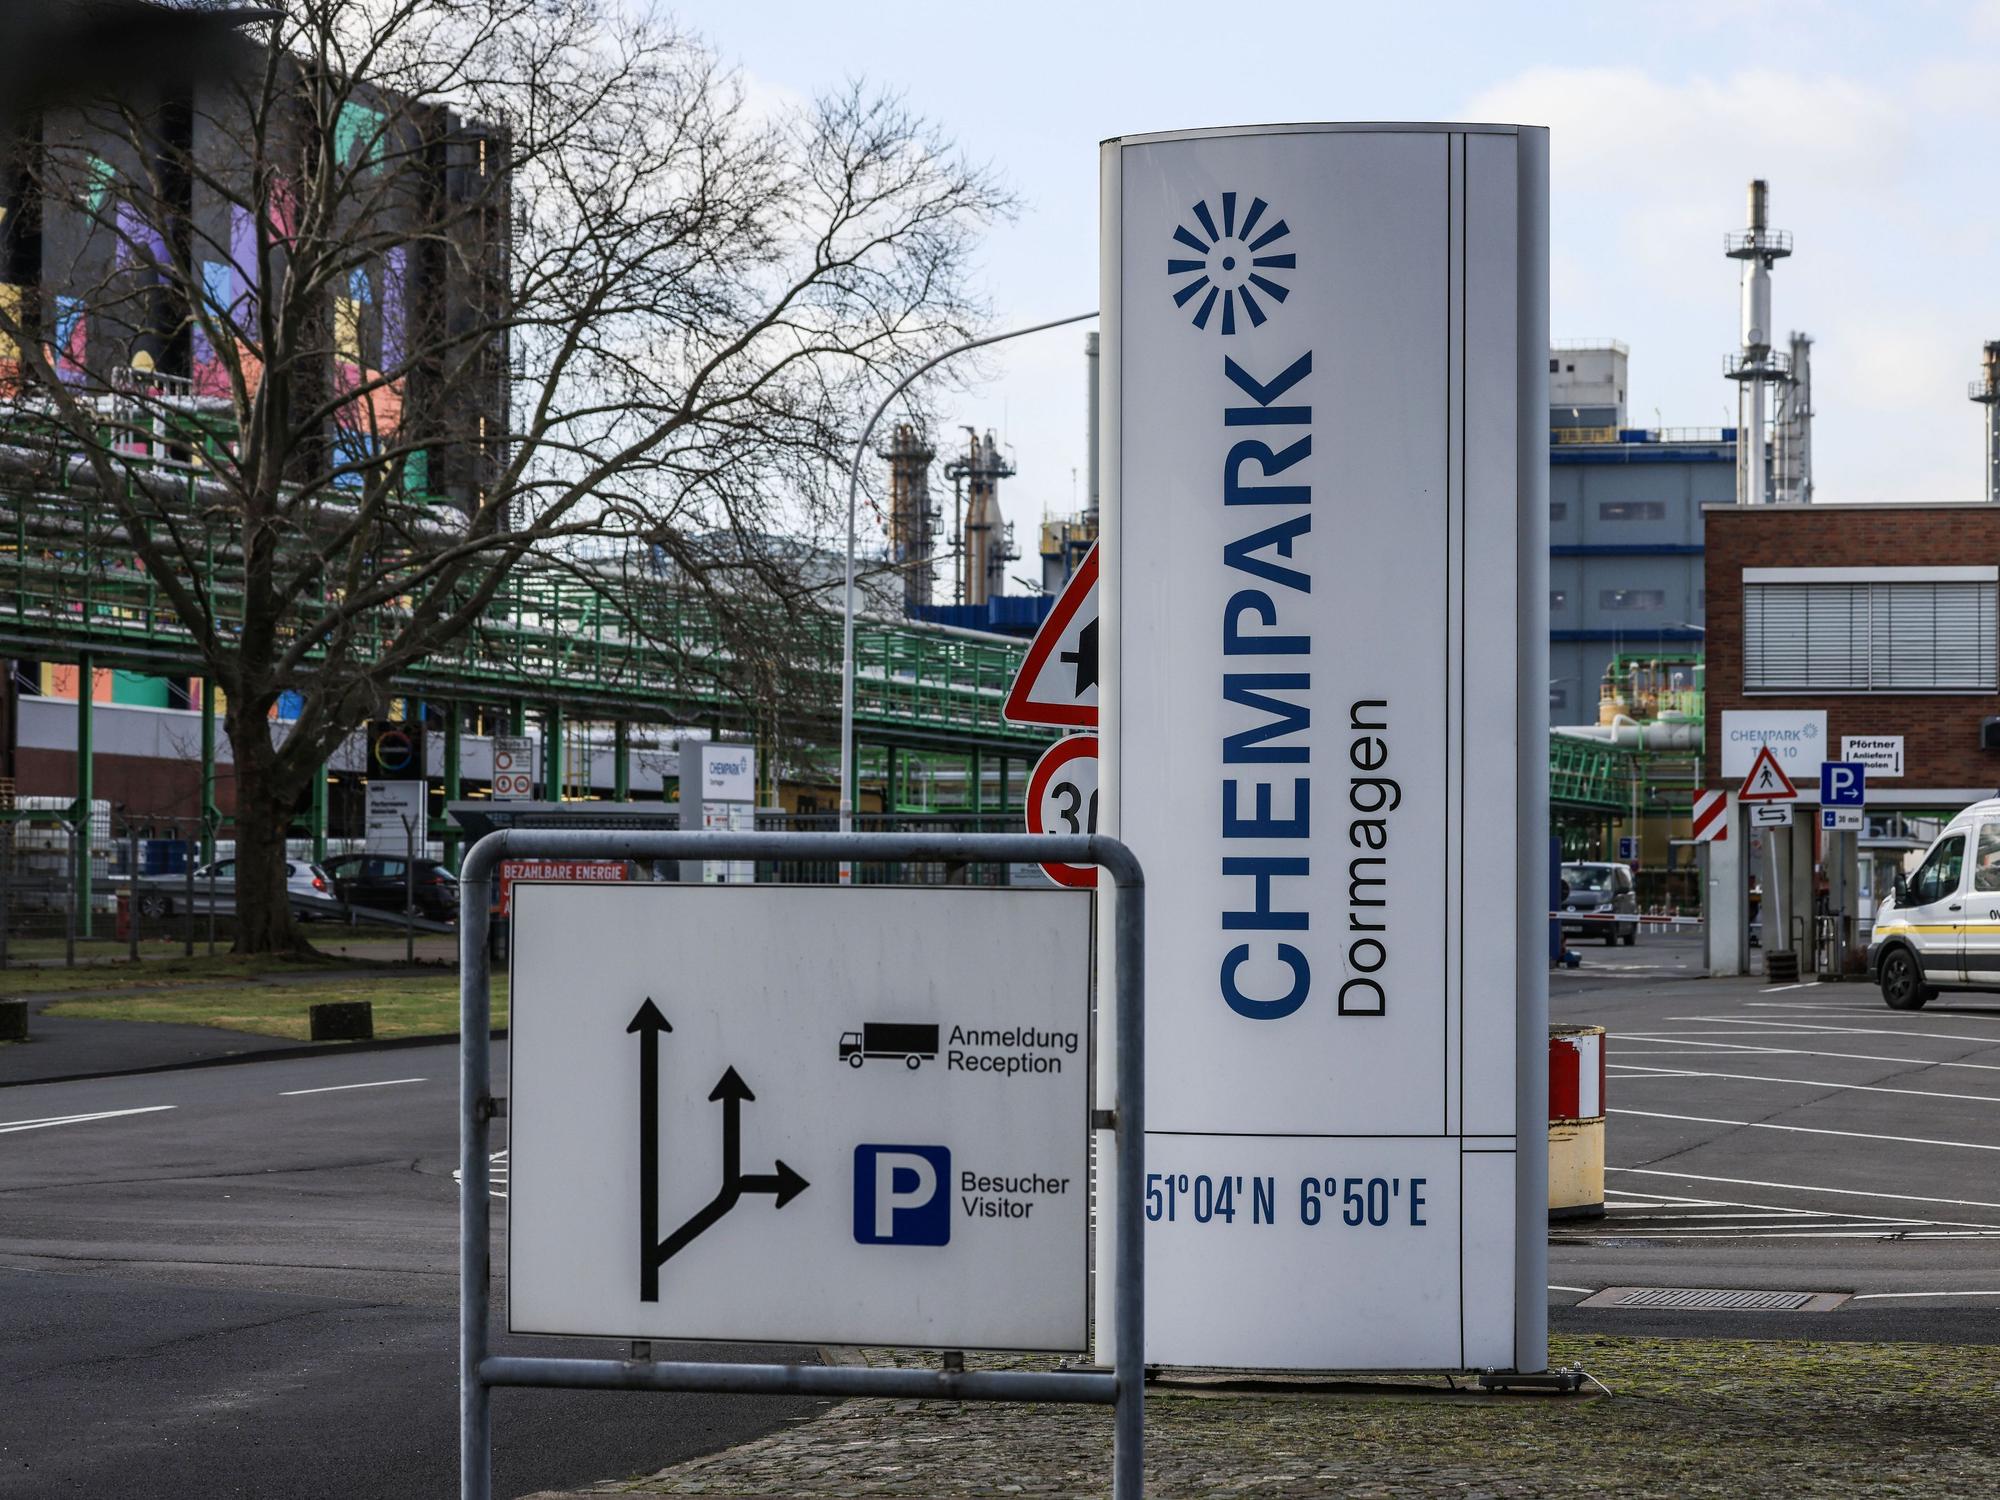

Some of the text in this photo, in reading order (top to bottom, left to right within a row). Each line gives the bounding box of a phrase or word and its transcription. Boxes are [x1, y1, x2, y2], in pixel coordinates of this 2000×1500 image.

[1220, 350, 1312, 1021] CHEMPARK
[1730, 729, 1801, 742] CHEMPARK
[1849, 739, 1895, 749] Pförtner
[1751, 746, 1798, 758] TR 10
[1852, 751, 1893, 759] Anliefern
[1830, 767, 1855, 801] P
[1337, 699, 1402, 1017] Dormagen
[503, 864, 623, 880] BEZAHLBARE ENERGIE
[949, 1025, 1079, 1053] Anmeldung
[948, 1050, 1062, 1077] Reception
[875, 1151, 937, 1238] P
[961, 1171, 1070, 1195] Besucher
[961, 1196, 1034, 1219] Visitor
[1253, 1176, 1275, 1225] N
[1409, 1178, 1427, 1227] E
